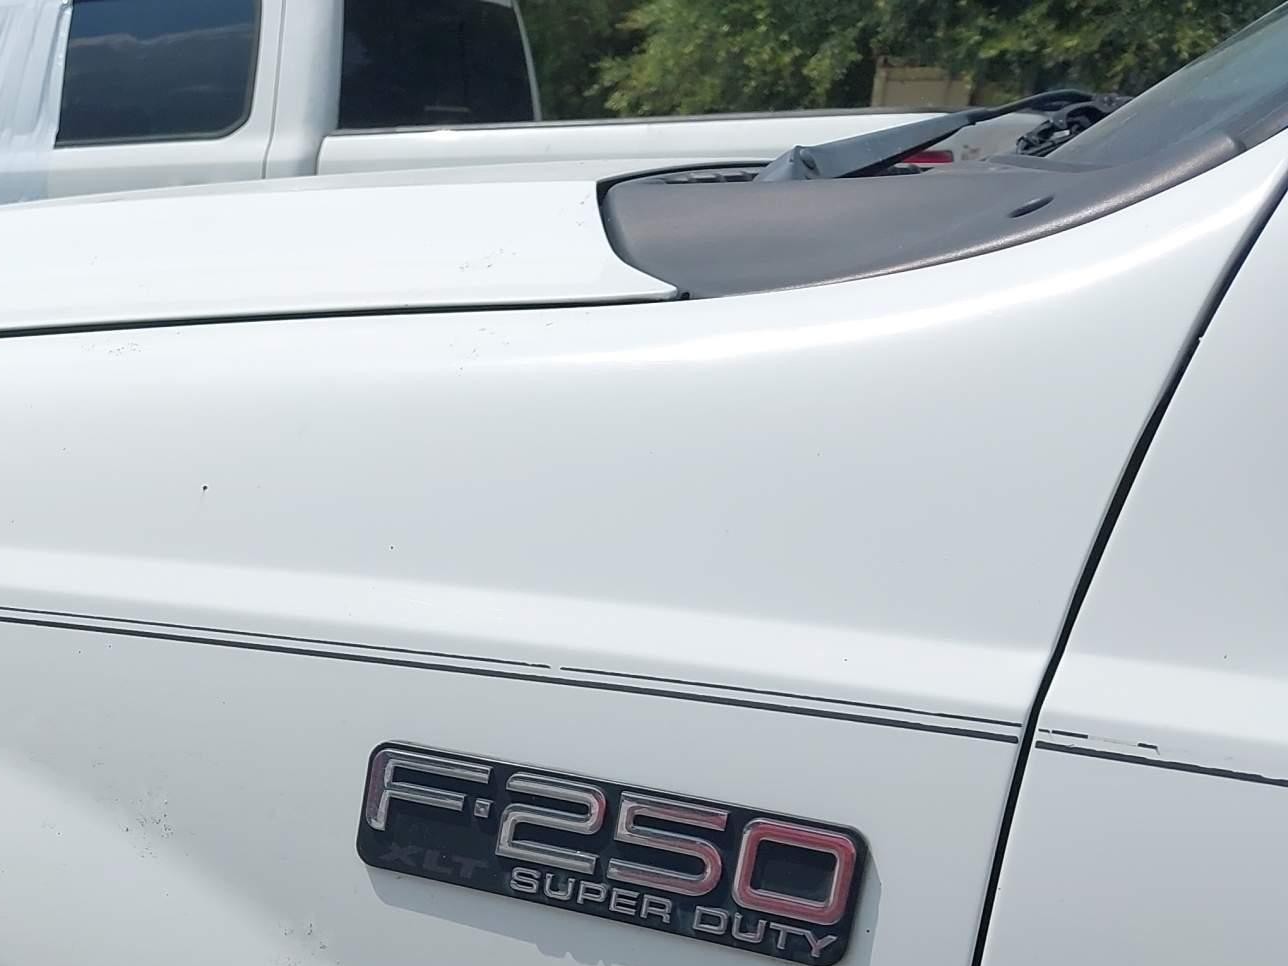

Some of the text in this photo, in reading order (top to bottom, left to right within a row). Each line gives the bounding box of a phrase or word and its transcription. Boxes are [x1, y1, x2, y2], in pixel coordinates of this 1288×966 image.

[377, 841, 488, 880] XLT
[509, 867, 838, 959] SUPER DUTY
